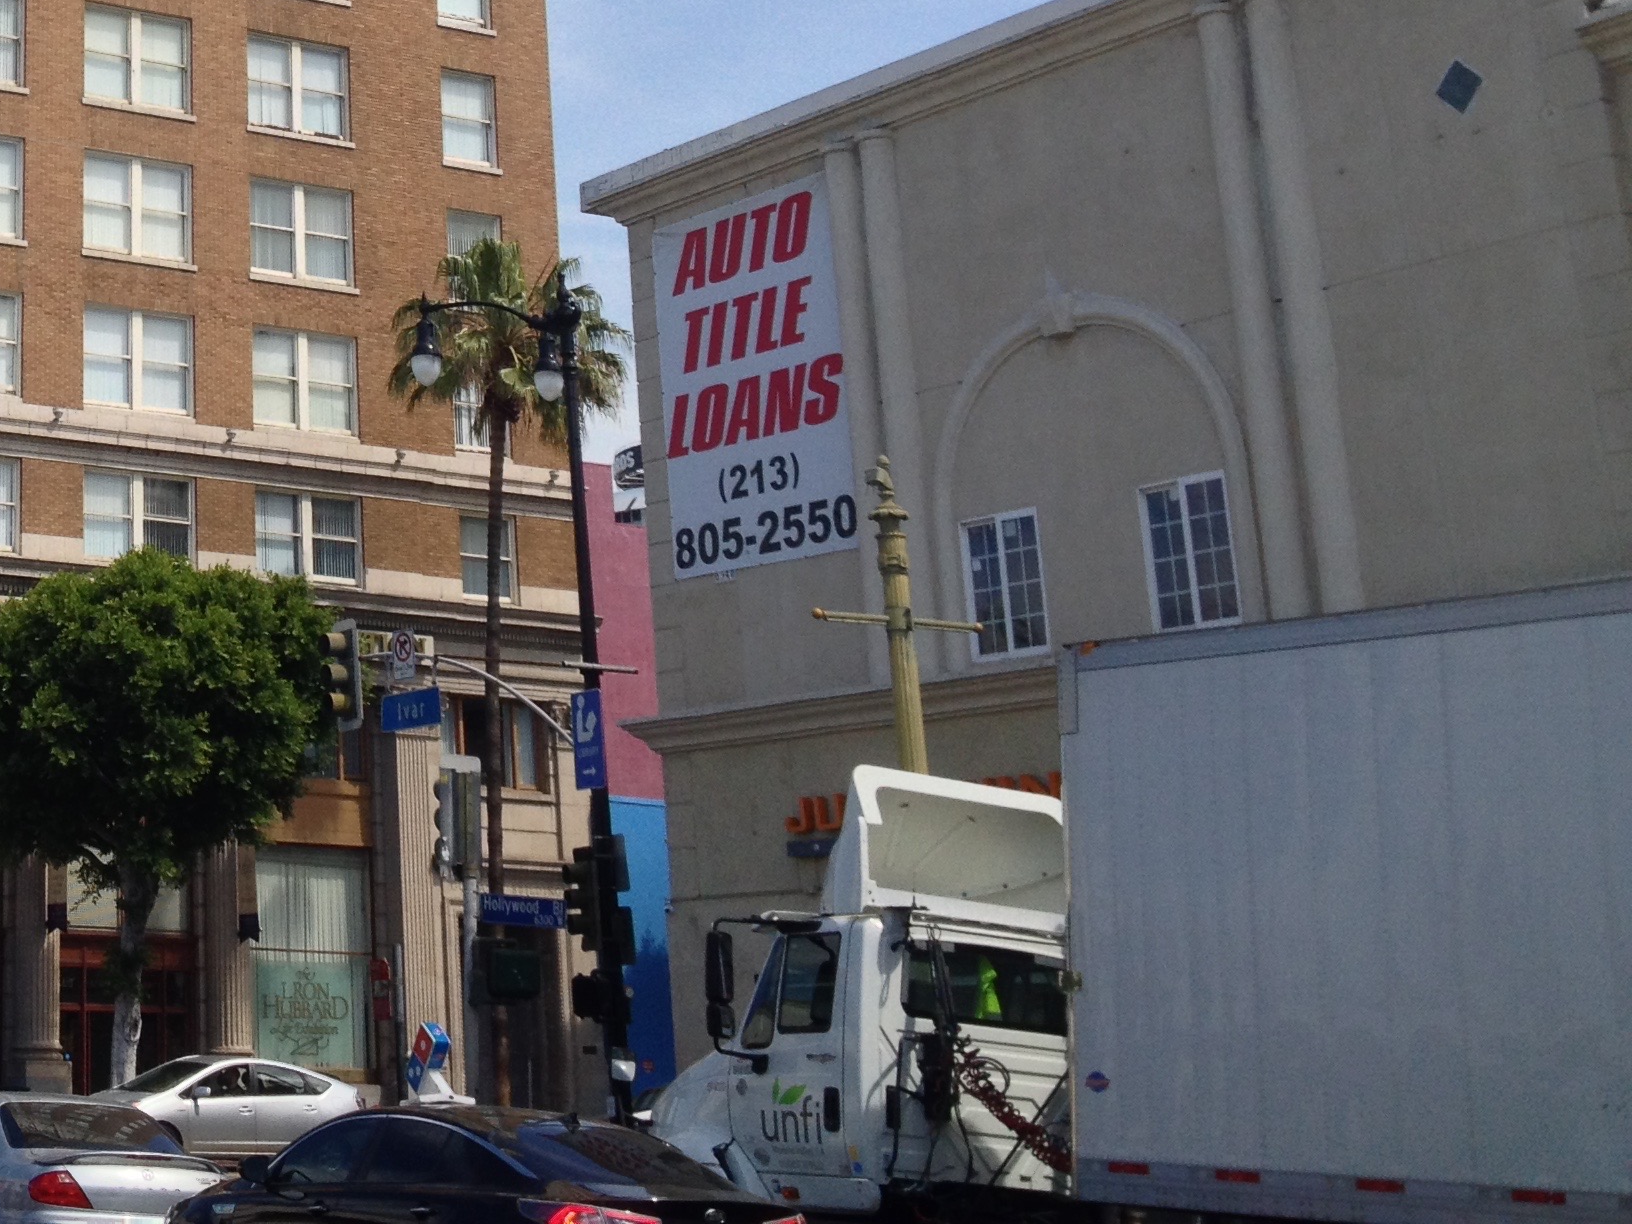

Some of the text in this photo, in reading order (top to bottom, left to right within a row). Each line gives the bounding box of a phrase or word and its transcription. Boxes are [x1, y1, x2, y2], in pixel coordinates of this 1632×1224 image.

[672, 191, 812, 297] AUTO
[683, 276, 812, 374] TITLE
[668, 353, 844, 459] LOANS
[718, 452, 799, 504] (213)
[675, 494, 858, 569] 805-2550
[398, 702, 425, 721] Ivar
[483, 895, 540, 916] Hollywood
[760, 1094, 823, 1145] unfi
